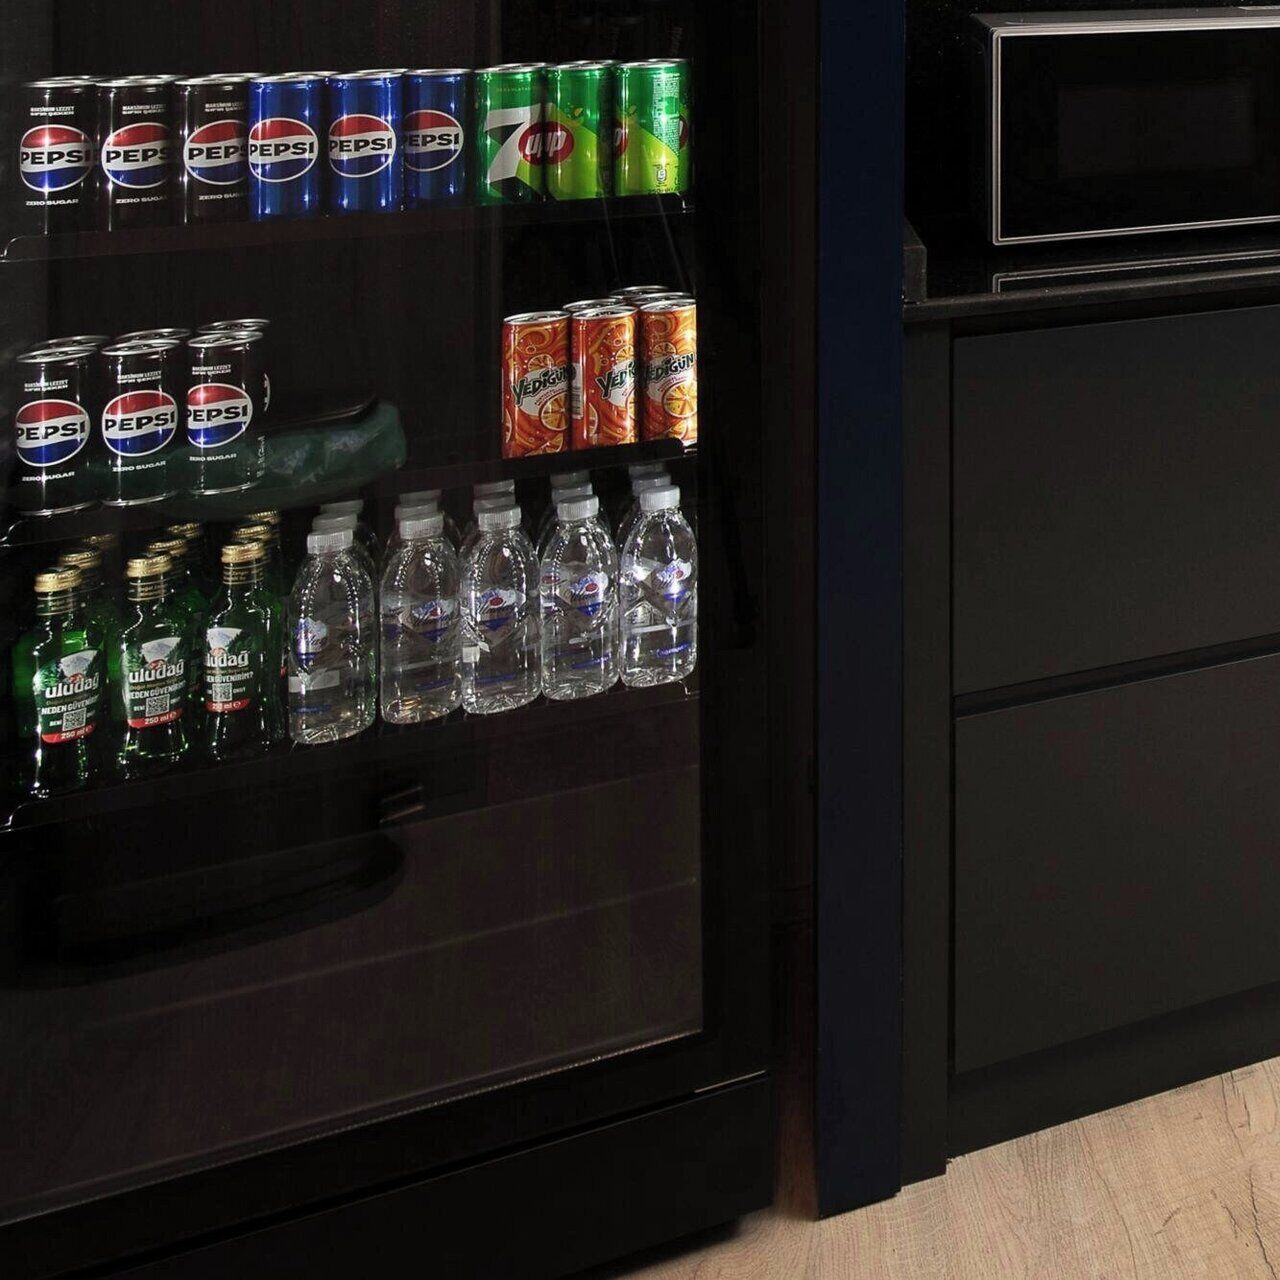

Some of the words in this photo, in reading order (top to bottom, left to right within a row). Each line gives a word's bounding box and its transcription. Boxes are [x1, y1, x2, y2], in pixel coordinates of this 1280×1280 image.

[21, 149, 91, 166] PEPSI
[105, 148, 167, 165] PEPS
[250, 142, 315, 157] PEPSI
[105, 411, 176, 432] PEPSI
